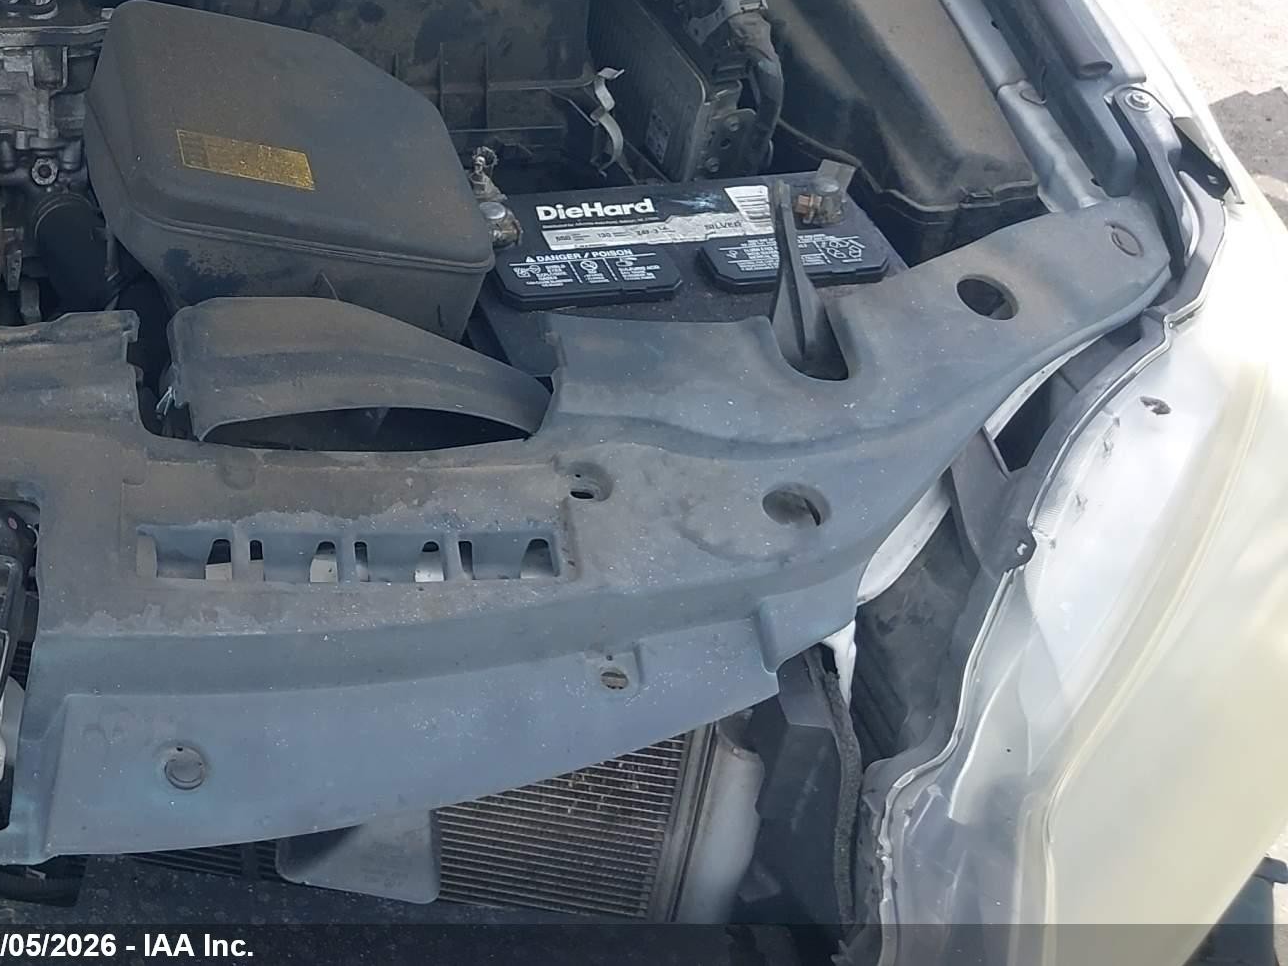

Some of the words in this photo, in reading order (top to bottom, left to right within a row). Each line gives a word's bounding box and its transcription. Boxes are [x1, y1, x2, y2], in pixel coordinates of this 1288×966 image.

[535, 198, 656, 222] DieHard
[536, 253, 581, 263] DANGER
[592, 248, 633, 258] POISON
